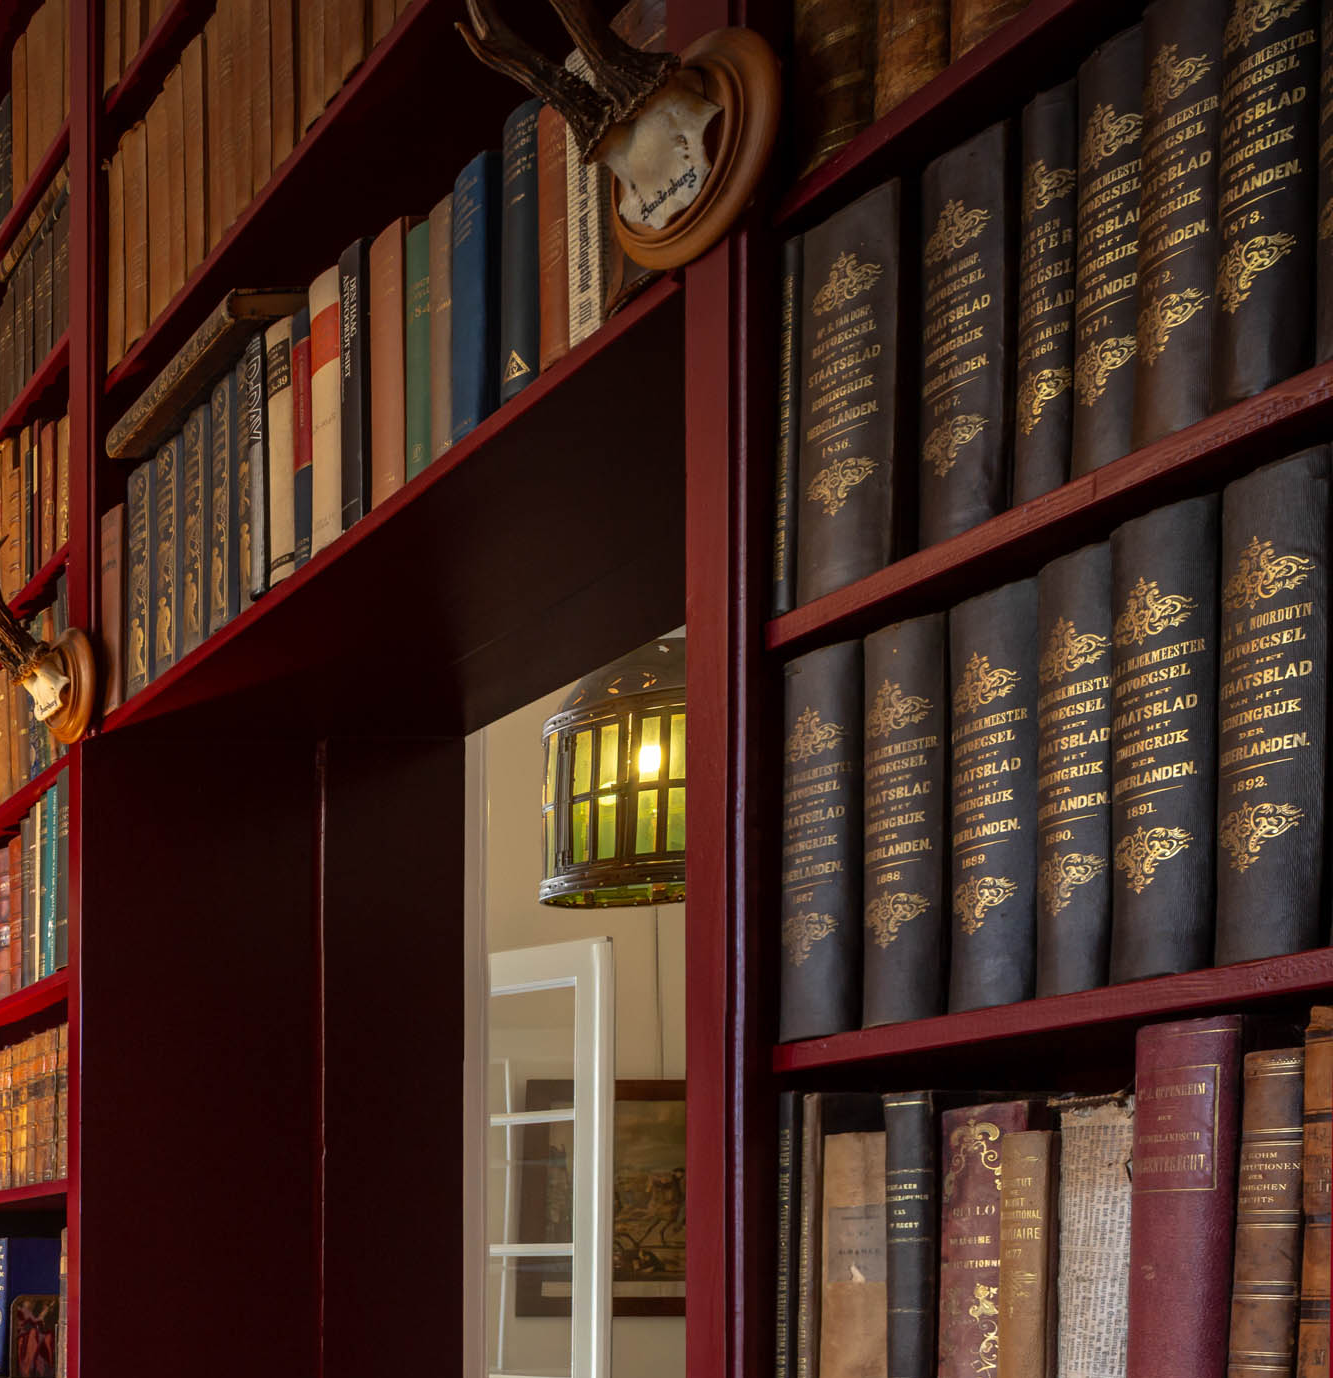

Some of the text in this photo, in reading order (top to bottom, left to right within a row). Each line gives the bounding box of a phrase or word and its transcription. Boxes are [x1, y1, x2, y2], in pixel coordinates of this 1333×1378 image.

[1221, 54, 1300, 106] VOEGSEL
[1220, 86, 1306, 140] AATSBLAD
[1247, 119, 1276, 138] HET
[1220, 125, 1295, 174] NINGRIJK
[1141, 150, 1212, 198] AATSBLAD
[1220, 158, 1303, 206] ERLANDEN.
[1139, 188, 1202, 231] INGRIJK
[1080, 207, 1141, 250] ATSBLA
[1098, 234, 1123, 250] HET
[1078, 241, 1139, 281] NINGRIJK
[349, 276, 357, 338] DEN HAAG
[926, 269, 985, 311] IJVOEGSEL
[342, 275, 351, 378] ANTWOORDT NIET
[924, 294, 991, 344] TAATSBLAD
[925, 326, 984, 369] ONINGRIJK
[808, 344, 881, 388] STAATSBLAD
[924, 353, 990, 396] EDERLANDEN.
[1250, 602, 1313, 632] NOORDUYN
[1222, 659, 1313, 700] TAATSBLAD
[1255, 687, 1283, 701] HET
[1038, 697, 1106, 730] JVOEGSEL
[1114, 693, 1198, 734] TAATSBLAD
[1146, 719, 1172, 732] HET
[1222, 698, 1302, 733] ONINGRIJK
[954, 729, 1016, 762] JVOEGSEL
[1038, 727, 1111, 762] AATSBLAD
[1063, 751, 1088, 763] HET
[1116, 729, 1190, 763] ONINGRIJK
[1221, 732, 1310, 767] EDERLANDEN.
[866, 754, 927, 781] JVOEGSEL
[953, 757, 1021, 790] AATSBLAD
[1038, 761, 1104, 791] NINGRIJK
[1114, 760, 1198, 797] DERLANDEN.
[866, 781, 932, 809] AATSBLAD
[953, 788, 1014, 818] NINGRIJK
[1037, 791, 1111, 823] ERLANDEN.
[785, 805, 845, 831] AATSBLAD
[866, 811, 926, 837] NINGRIJK
[953, 817, 1021, 849] DERLANDEN.
[865, 838, 933, 865] ERLANDEN.
[784, 860, 844, 884] ERLANDEN.
[1136, 1154, 1210, 1174] MEENTERECHT.
[1242, 1162, 1301, 1171] TITUTIONEN
